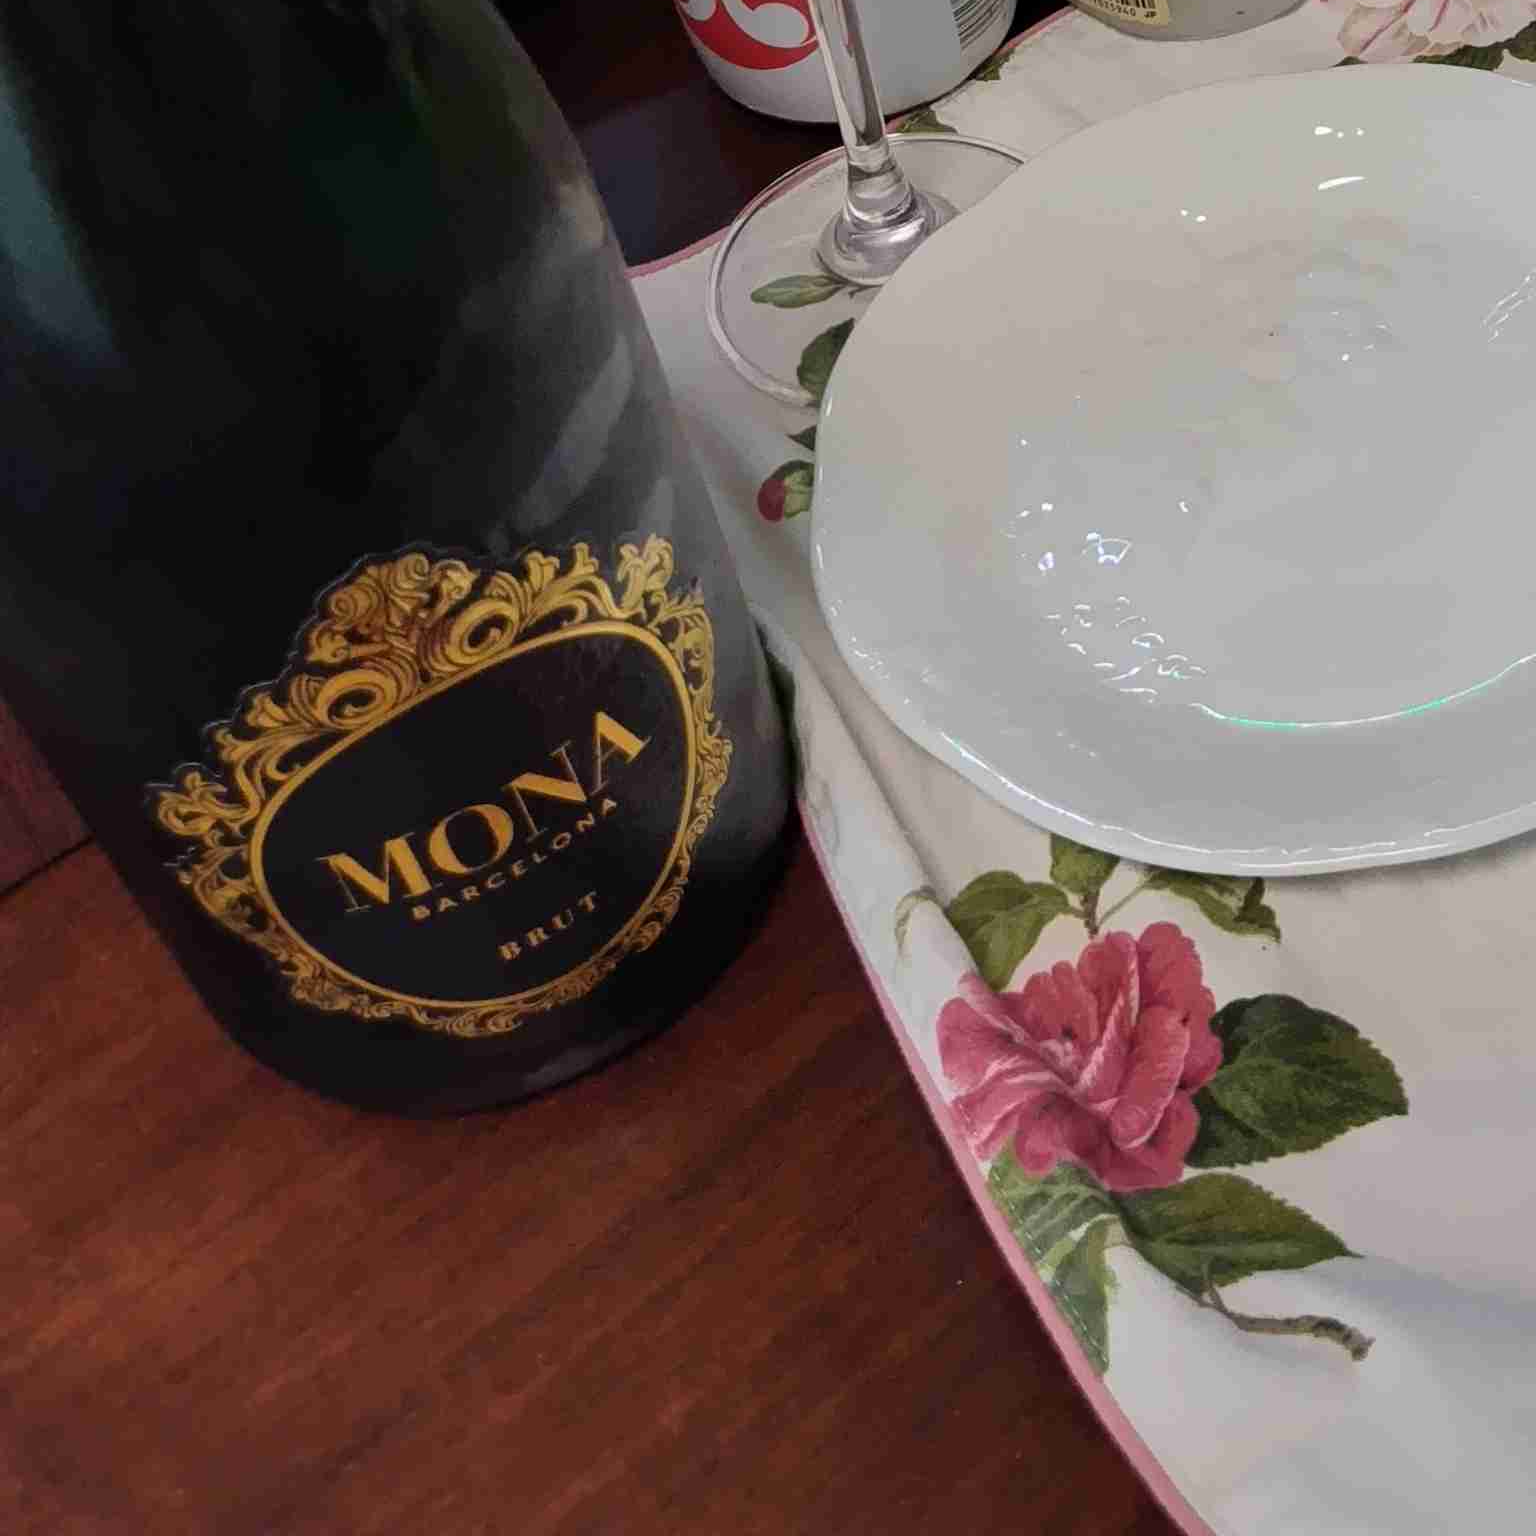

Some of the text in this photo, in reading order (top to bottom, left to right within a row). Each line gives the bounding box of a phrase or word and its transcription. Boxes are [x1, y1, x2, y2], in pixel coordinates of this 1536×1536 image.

[314, 711, 652, 914] MONA
[411, 797, 618, 922] BARCELONA
[499, 891, 598, 961] BRUT
